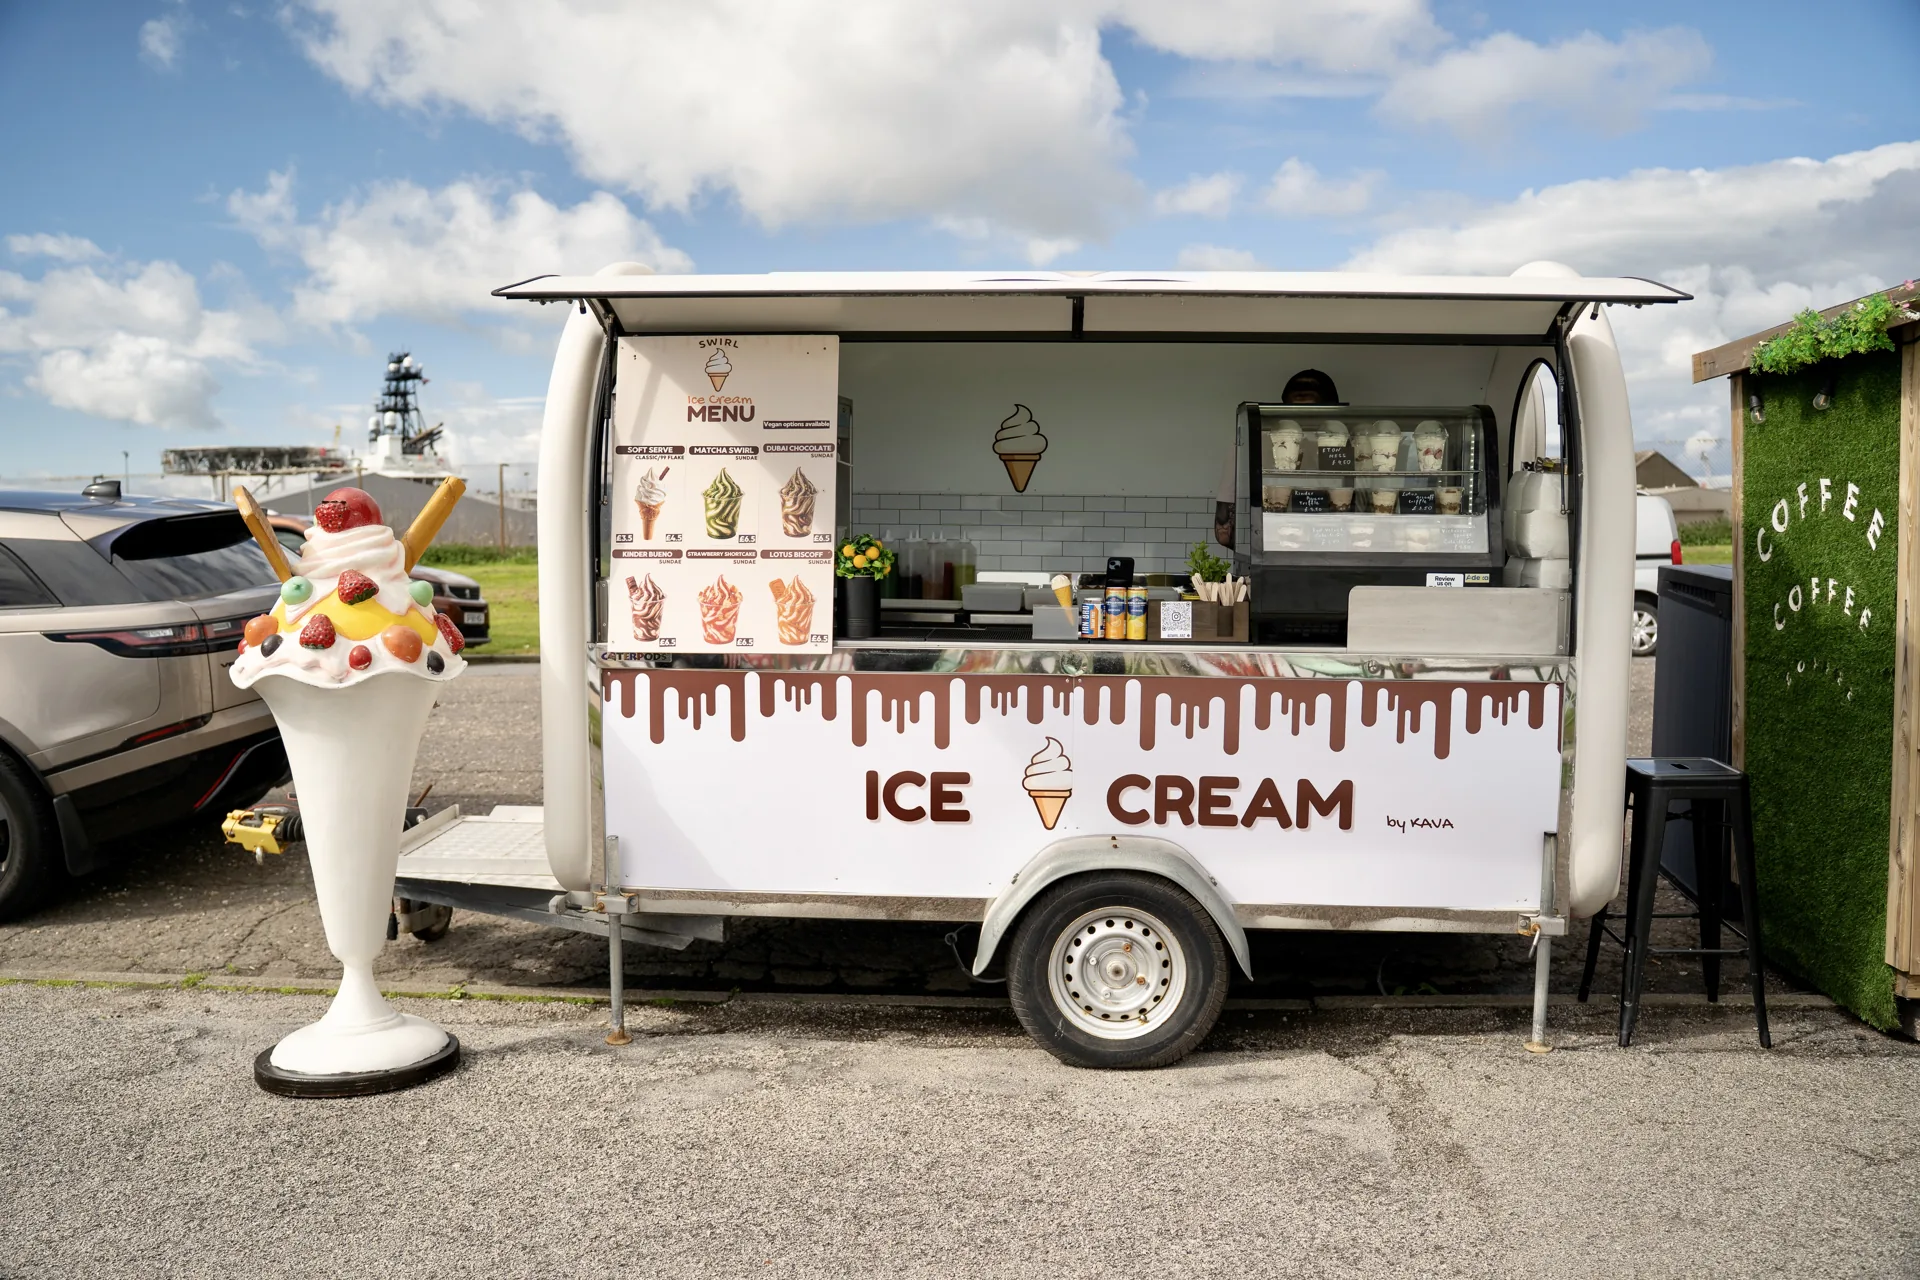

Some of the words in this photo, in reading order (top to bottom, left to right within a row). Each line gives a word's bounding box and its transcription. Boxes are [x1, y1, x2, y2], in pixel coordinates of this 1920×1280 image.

[698, 338, 739, 349] SWIRL
[687, 395, 705, 405] Ice
[709, 394, 753, 405] Cream
[687, 405, 755, 422] MENU
[763, 421, 783, 429] Vegan
[783, 421, 804, 429] options
[627, 446, 648, 454] SOFT
[648, 446, 674, 454] SERVE
[694, 446, 727, 454] MATCHA
[728, 446, 754, 454] SWIRL
[1757, 478, 1885, 562] COFFEE
[616, 534, 633, 542] £3.5
[666, 534, 683, 542] £4.5
[739, 535, 756, 543] £6.5
[813, 534, 831, 542] £6.5
[659, 638, 676, 646] £6.5
[736, 638, 754, 646] £6.5
[811, 635, 828, 643] £6.5
[866, 769, 971, 824] ICE
[1106, 773, 1355, 832] CREAM
[1386, 814, 1406, 834] by
[1410, 816, 1455, 830] KAVA
